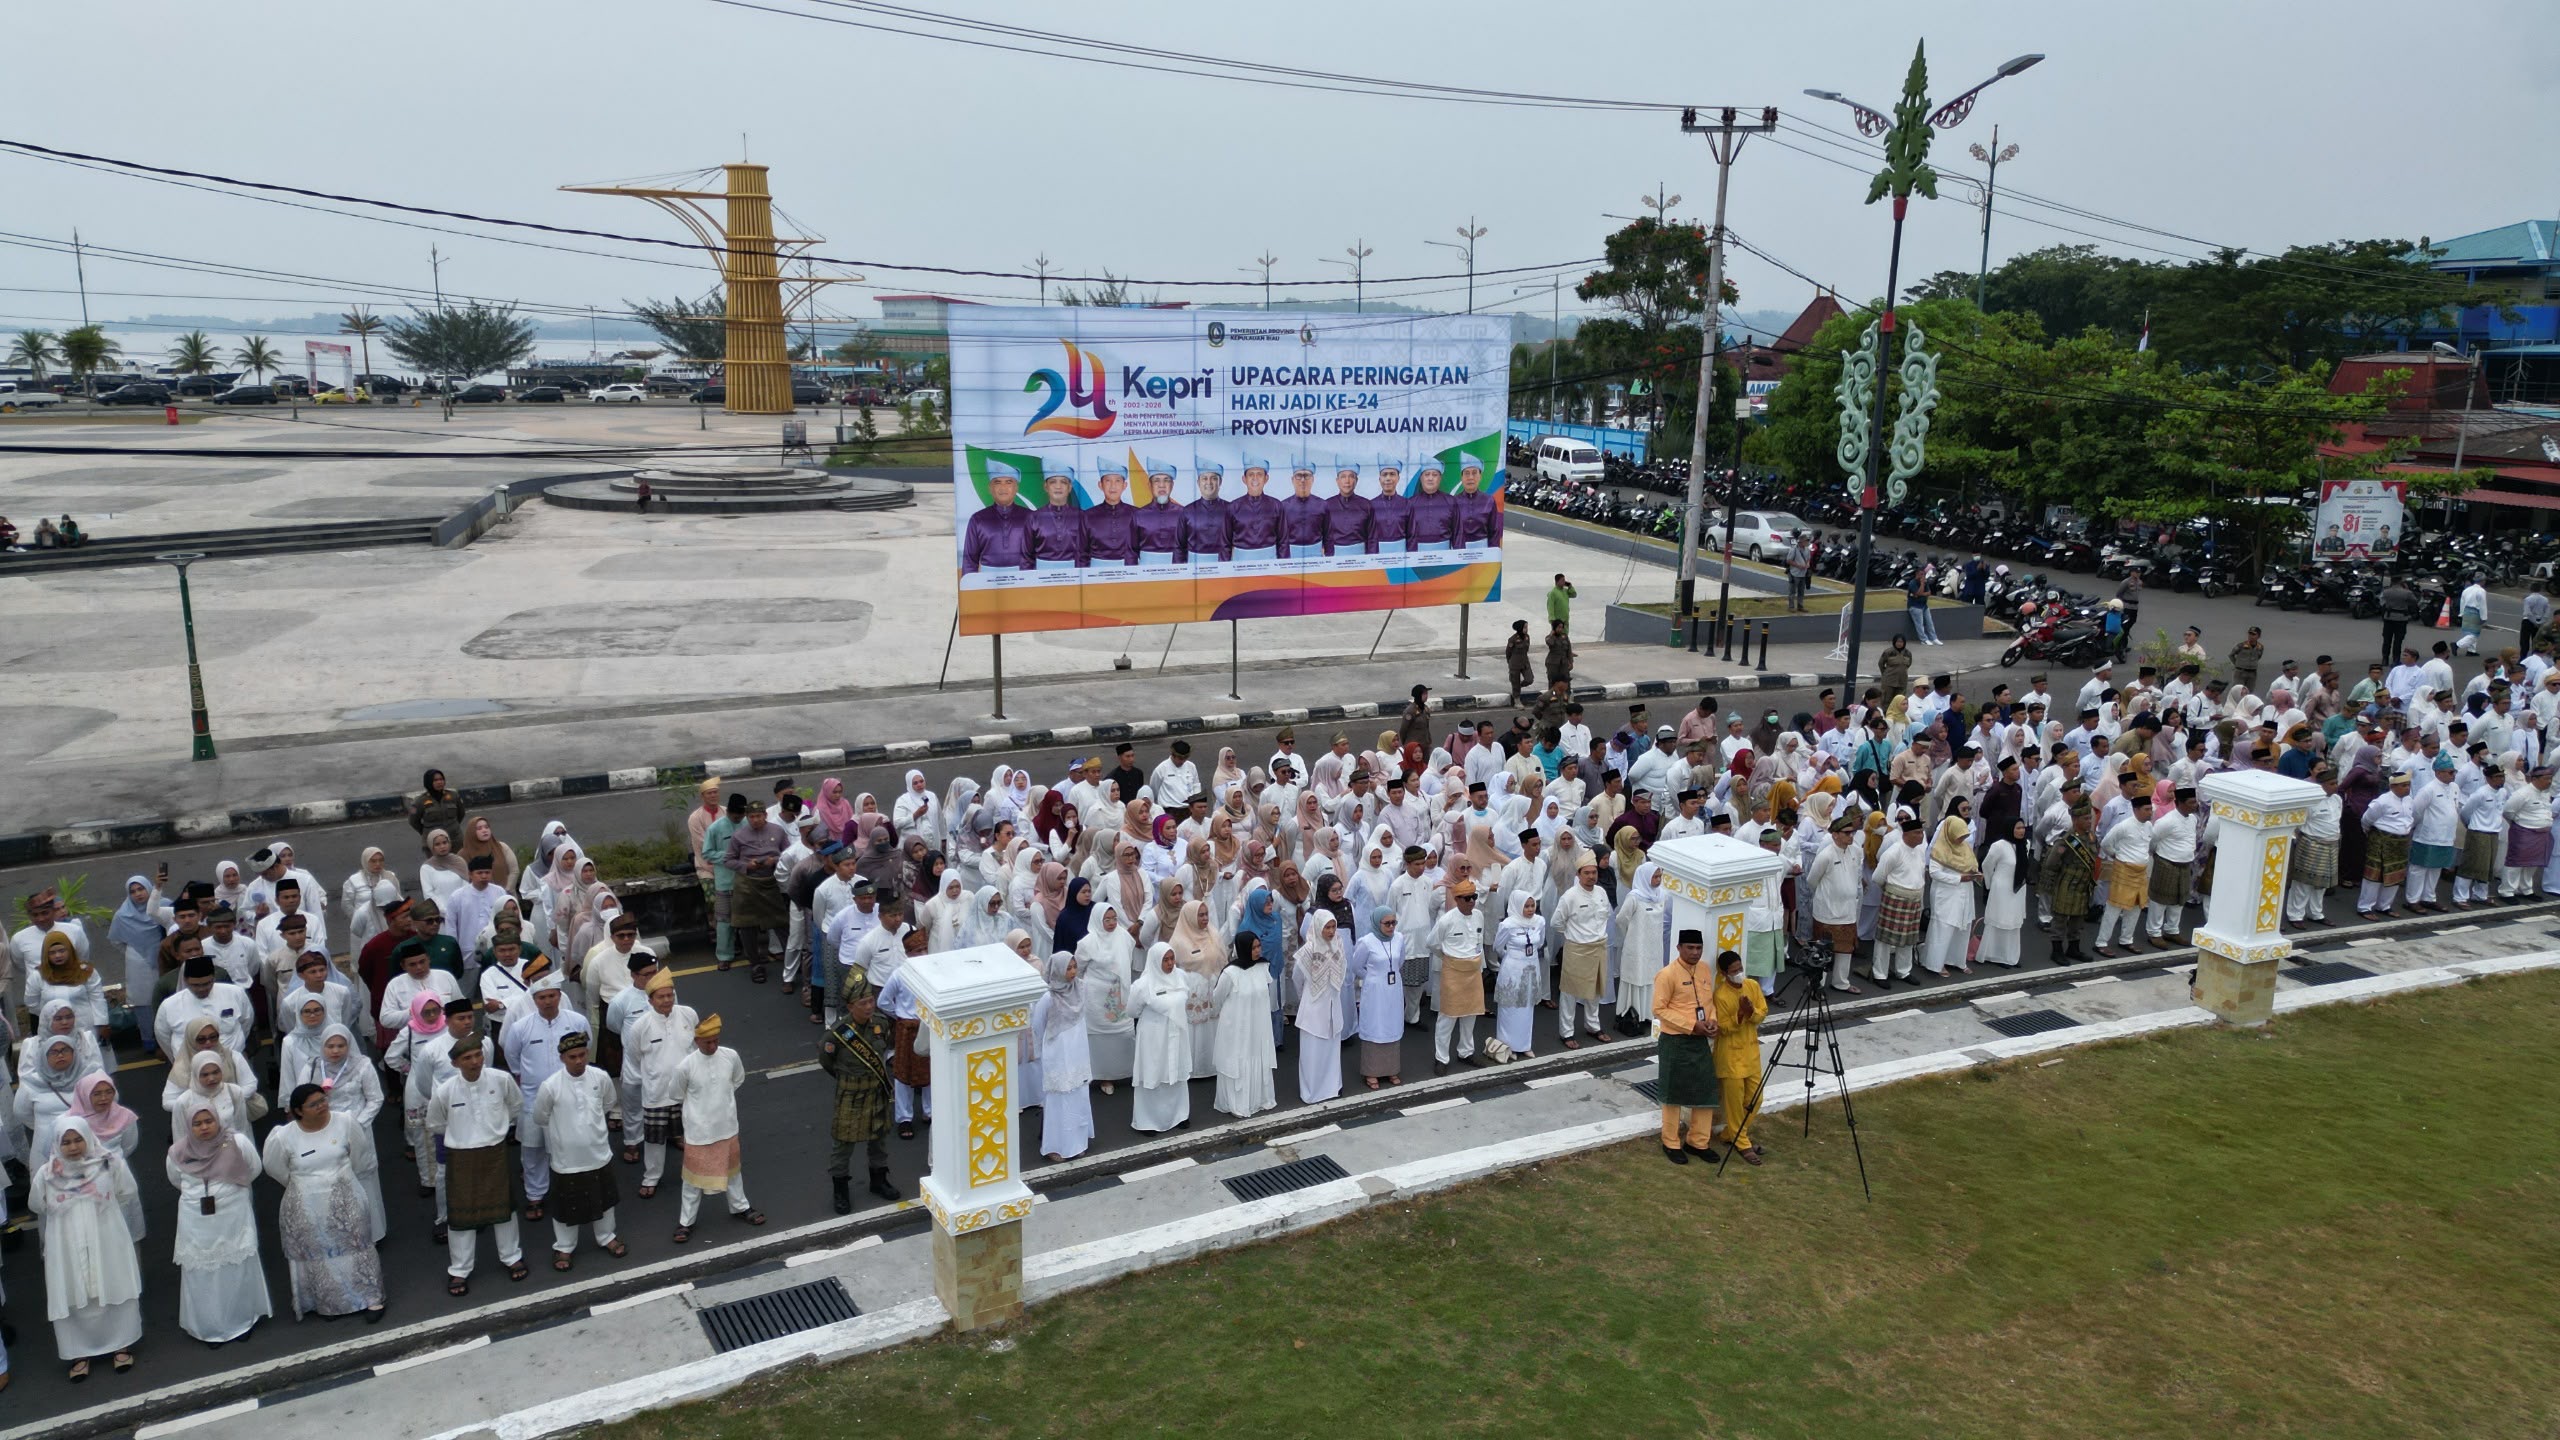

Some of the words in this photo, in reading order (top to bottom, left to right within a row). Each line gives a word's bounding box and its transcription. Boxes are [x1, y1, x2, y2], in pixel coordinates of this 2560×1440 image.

[1231, 366, 1336, 385] UPACARA
[1341, 366, 1468, 385] PERINGATAN
[1123, 366, 1214, 410] Kepri
[1231, 394, 1275, 411] HARI
[1280, 393, 1321, 410] JADI
[1325, 393, 1379, 410] KE-24
[1231, 418, 1317, 436] PROVINSI
[1321, 417, 1424, 435] KEPULAUAN
[1428, 416, 1467, 433] RIAU
